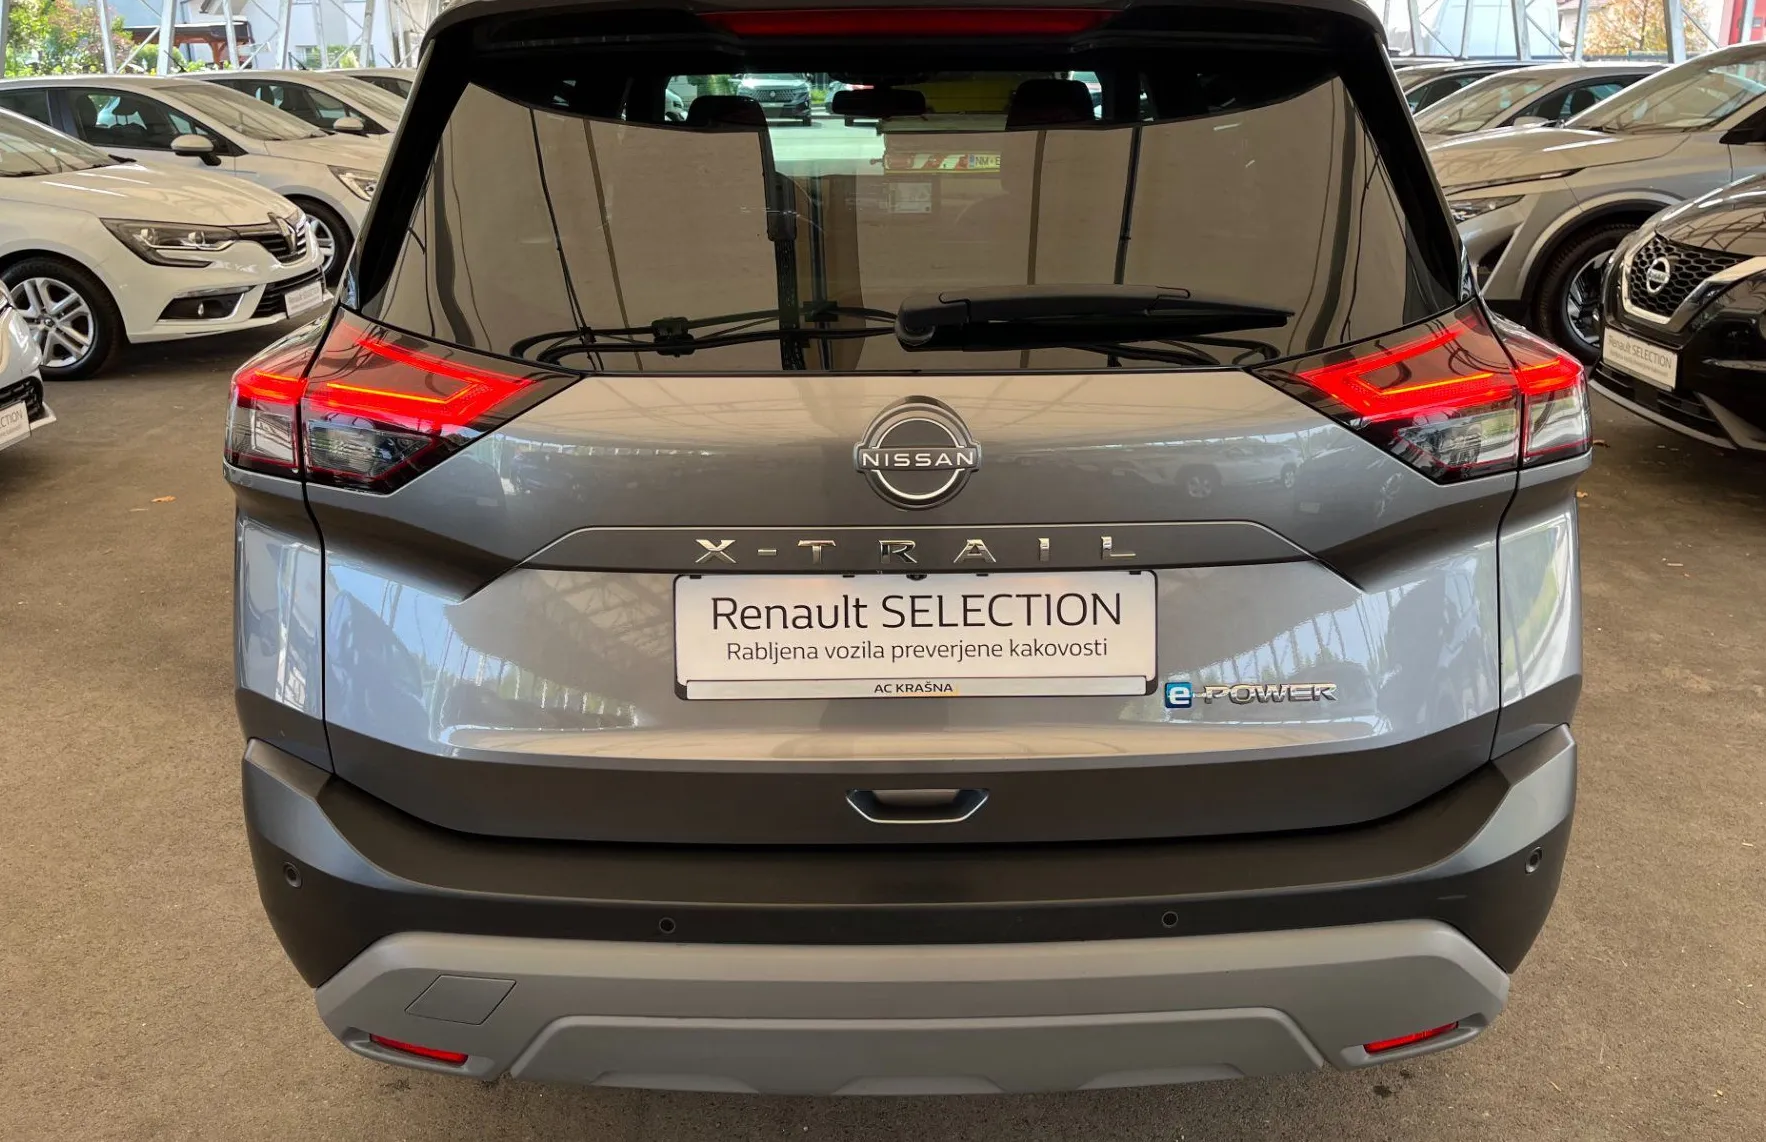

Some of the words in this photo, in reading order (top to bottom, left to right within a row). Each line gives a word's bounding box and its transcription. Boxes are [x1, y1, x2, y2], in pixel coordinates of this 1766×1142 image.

[1631, 344, 1673, 370] SELECTION
[862, 451, 974, 467] NISSAN
[695, 536, 1137, 564] X-TRAIL
[711, 594, 869, 631] Renault
[881, 592, 1122, 629] SELECTION
[726, 641, 819, 665] Rabljena
[825, 640, 886, 660] vozila
[891, 638, 1004, 663] preverjene
[1009, 638, 1108, 657] kakovosti
[873, 683, 893, 694] AC
[895, 681, 954, 694] KRAŠNA
